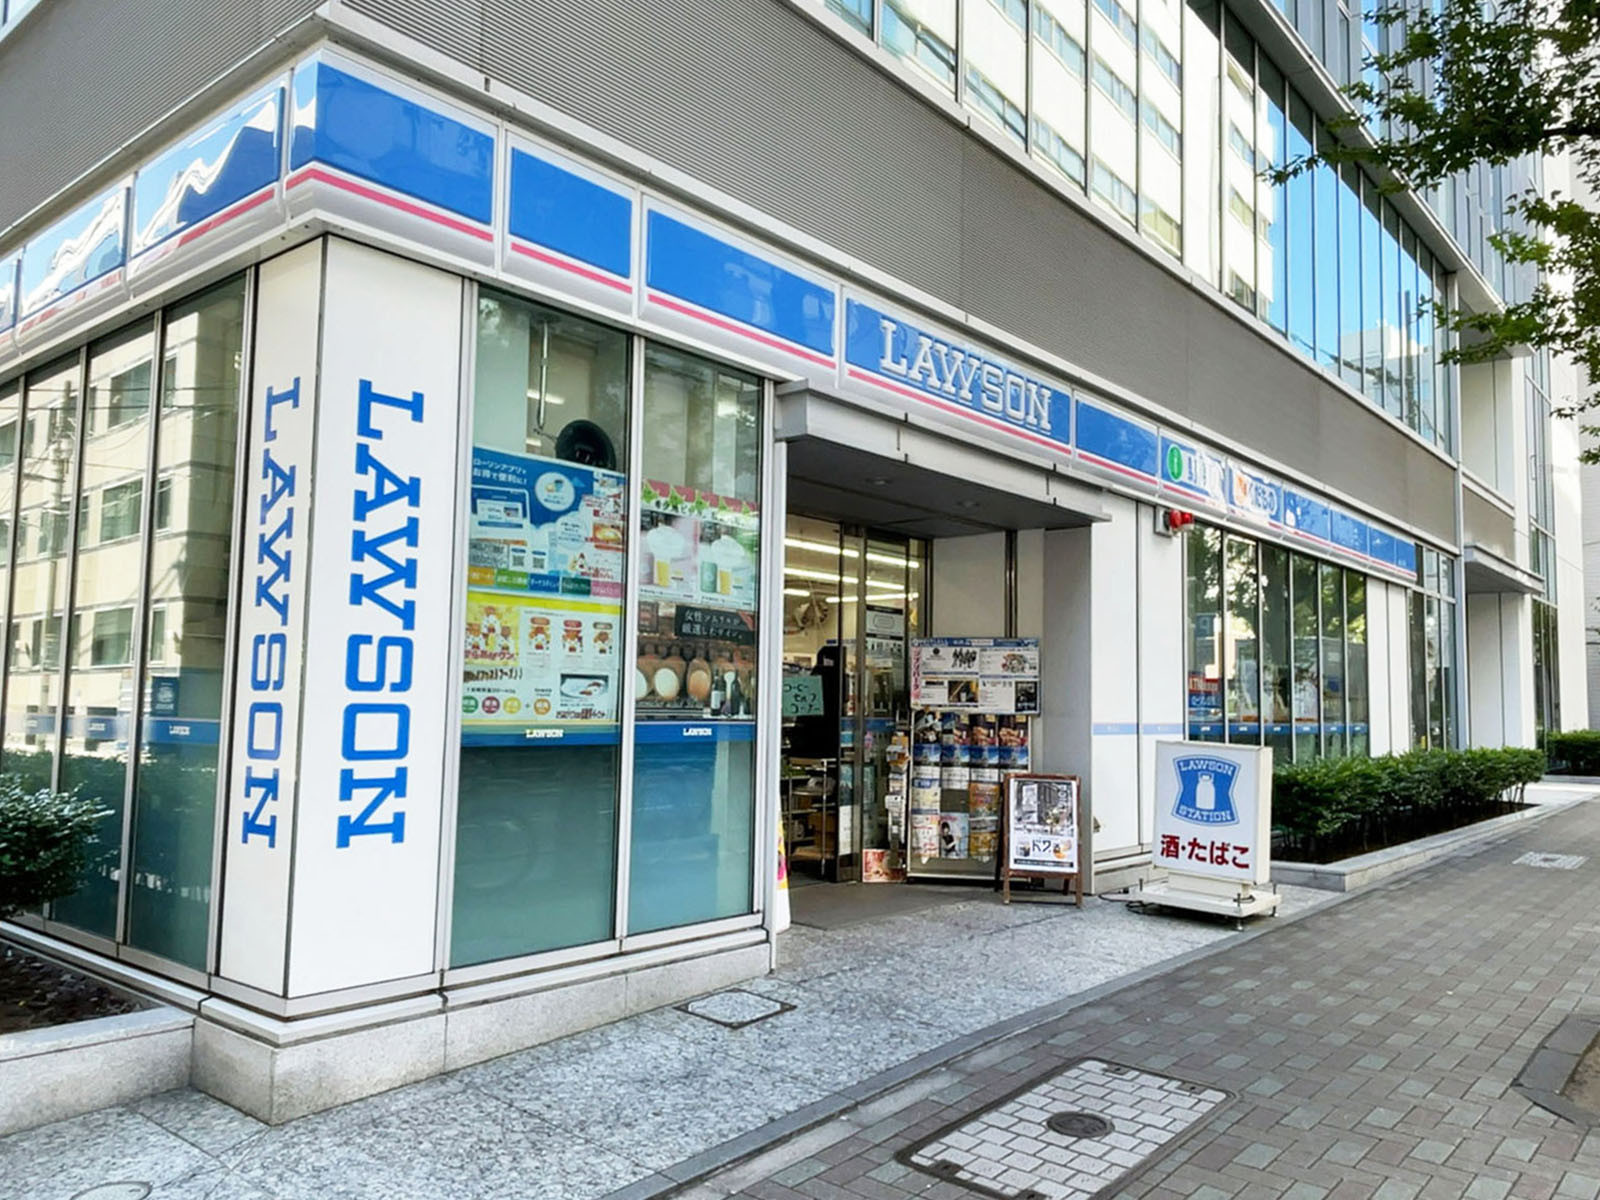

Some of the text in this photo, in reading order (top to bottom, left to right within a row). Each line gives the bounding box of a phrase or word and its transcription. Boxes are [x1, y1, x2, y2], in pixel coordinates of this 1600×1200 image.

[880, 318, 1052, 432] LAWSON
[241, 376, 301, 849] LAWSON
[335, 378, 425, 849] LAWSON
[526, 728, 564, 738] LAWSON
[683, 726, 712, 736] LAWSON
[1179, 759, 1234, 776] LAWSON
[1178, 805, 1231, 822] STATION
[1160, 833, 1250, 869] 酒・たばこ
